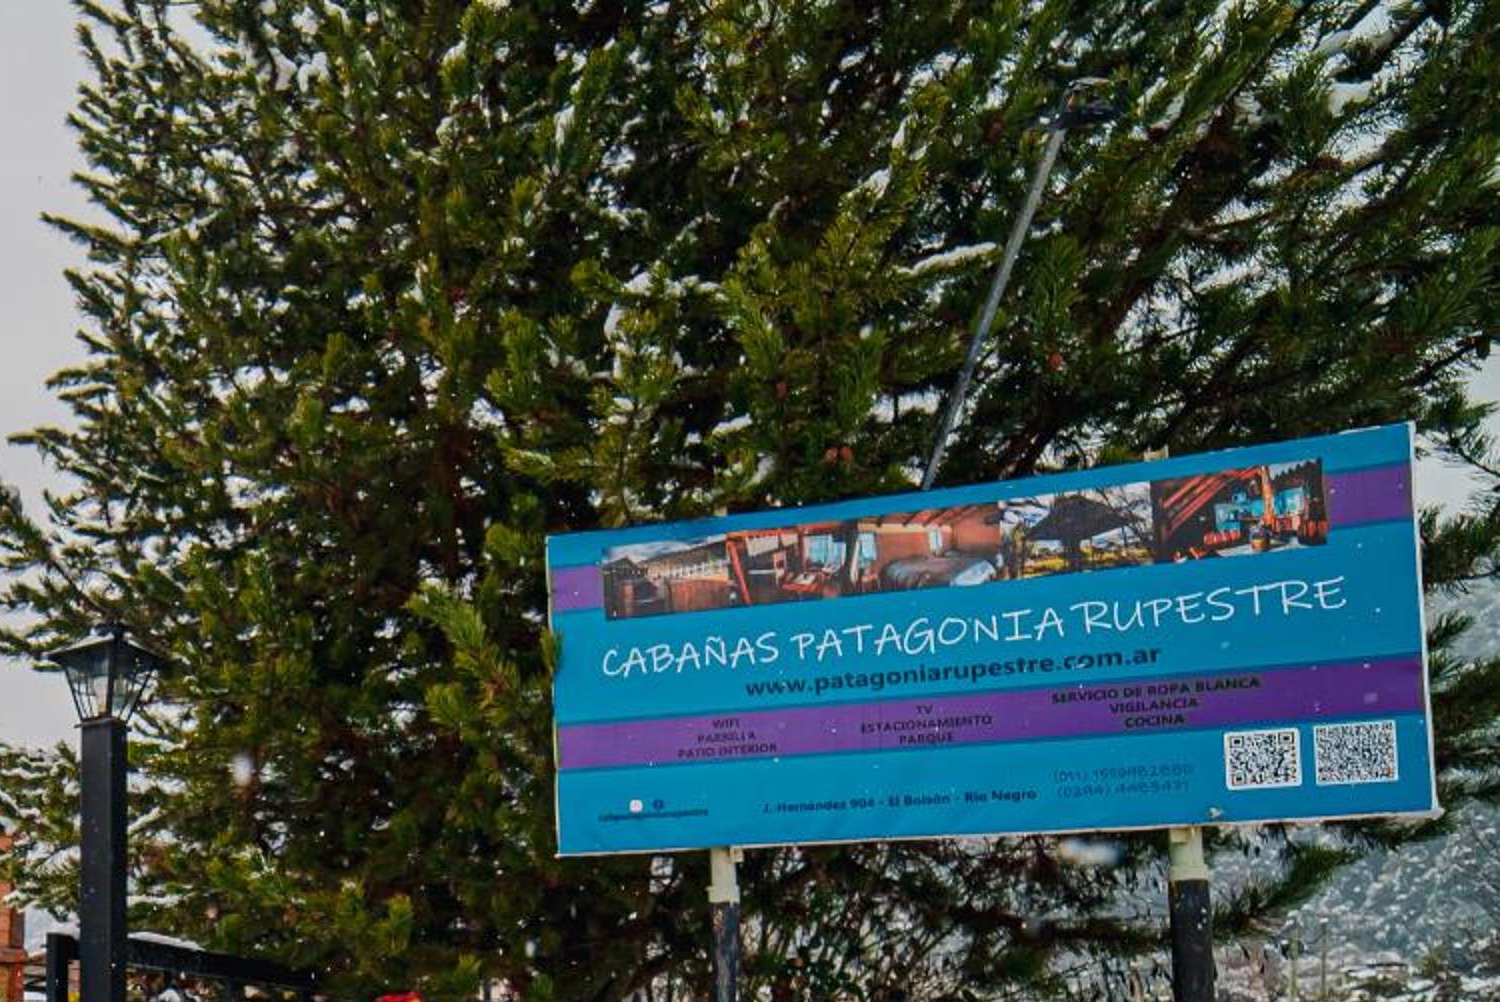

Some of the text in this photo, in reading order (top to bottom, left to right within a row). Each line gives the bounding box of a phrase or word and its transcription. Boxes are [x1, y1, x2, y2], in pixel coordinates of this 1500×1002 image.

[601, 575, 1348, 679] CABAÑAS PATAGONIA RUPESTRE
[745, 647, 1162, 697] www.patagoniarupestre.com.ar
[1051, 677, 1261, 705] SERVICIO DE ROPA BLANCA
[916, 704, 934, 714] TV
[1109, 697, 1200, 714] VIGILANCIA
[712, 718, 741, 729] WIFI
[860, 714, 994, 735] ESTACIONAMIENTO
[1123, 713, 1187, 729] COCINA
[899, 731, 954, 745] PARQUE
[677, 742, 778, 759] PATIO INTERIOR
